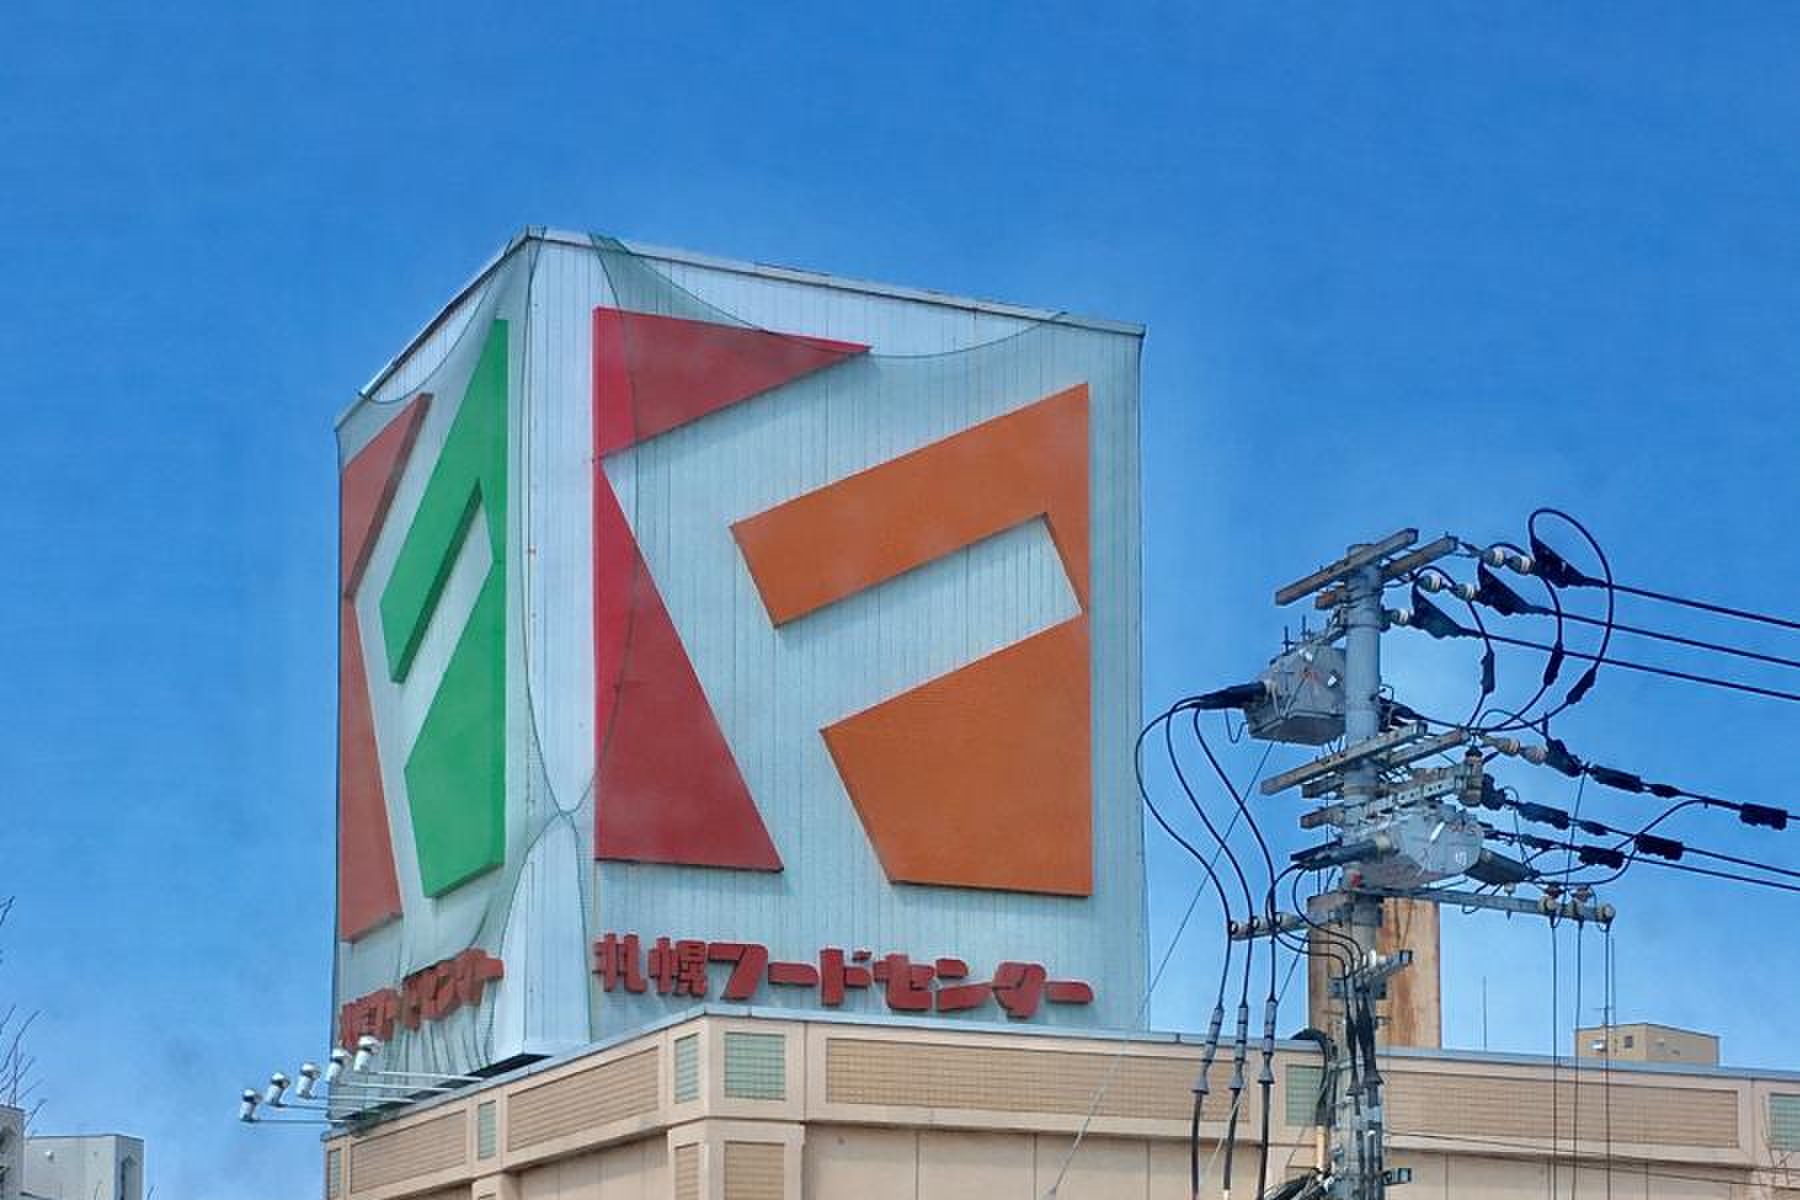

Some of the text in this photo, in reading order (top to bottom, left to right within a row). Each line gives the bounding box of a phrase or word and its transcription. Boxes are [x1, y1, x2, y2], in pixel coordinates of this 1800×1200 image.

[593, 933, 1094, 1018] 札幌フードセンター
